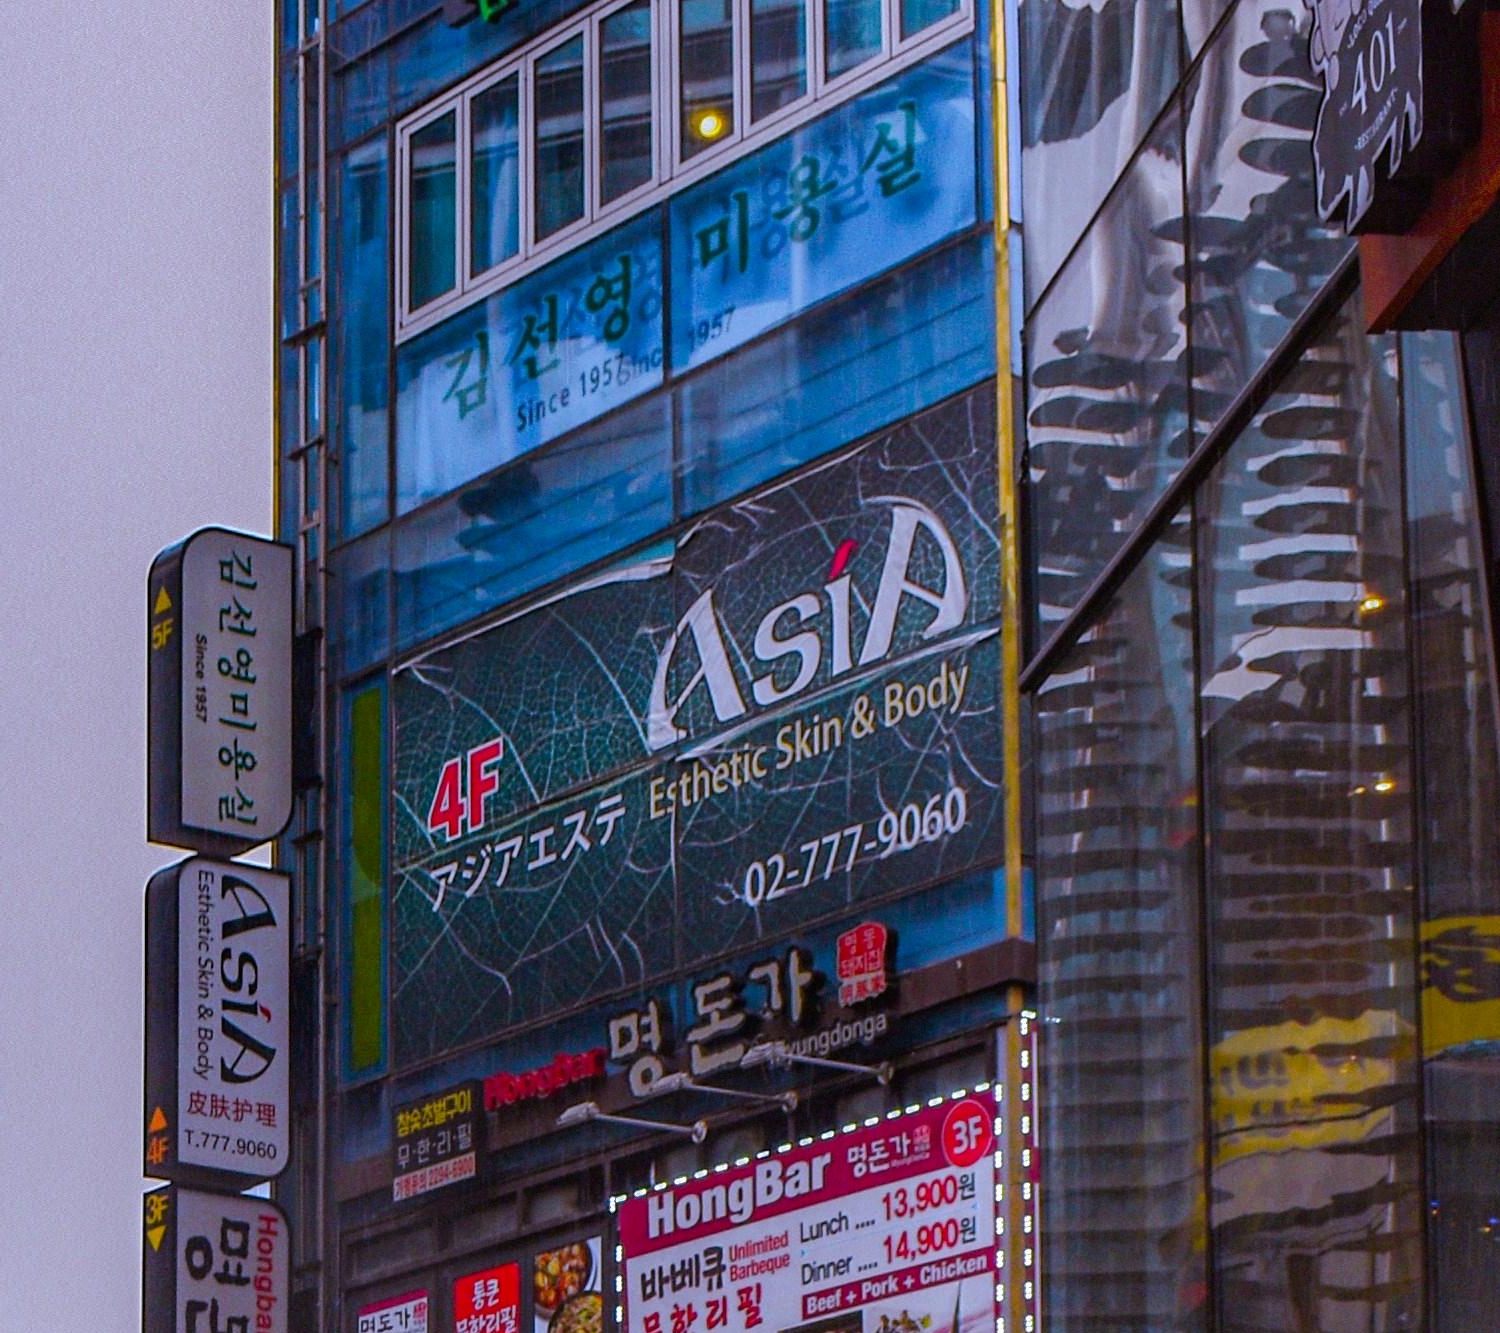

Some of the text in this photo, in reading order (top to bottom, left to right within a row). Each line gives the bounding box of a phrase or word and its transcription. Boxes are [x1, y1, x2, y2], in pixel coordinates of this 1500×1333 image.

[442, 99, 923, 420] 김선영 미용실
[151, 619, 174, 650] 5F
[195, 633, 208, 680] Since
[216, 550, 258, 826] 김선영미용실
[648, 659, 970, 822] Esthetic Skin & Body
[426, 737, 504, 841] 4F
[430, 792, 627, 913] アジアエステ
[744, 785, 967, 908] 02-777-9060
[193, 869, 214, 1081] Esthetic Skin Body
[186, 1089, 278, 1128] 皮肤护理
[951, 1113, 983, 1154] 3F
[184, 1128, 278, 1160] T.777.9060
[647, 1151, 832, 1240] HongBar
[639, 1245, 728, 1302] 바베큐
[727, 1230, 789, 1262] Unlimited
[728, 1252, 791, 1283] Barbeque
[805, 1254, 988, 1315] Beef Pork Chicken
